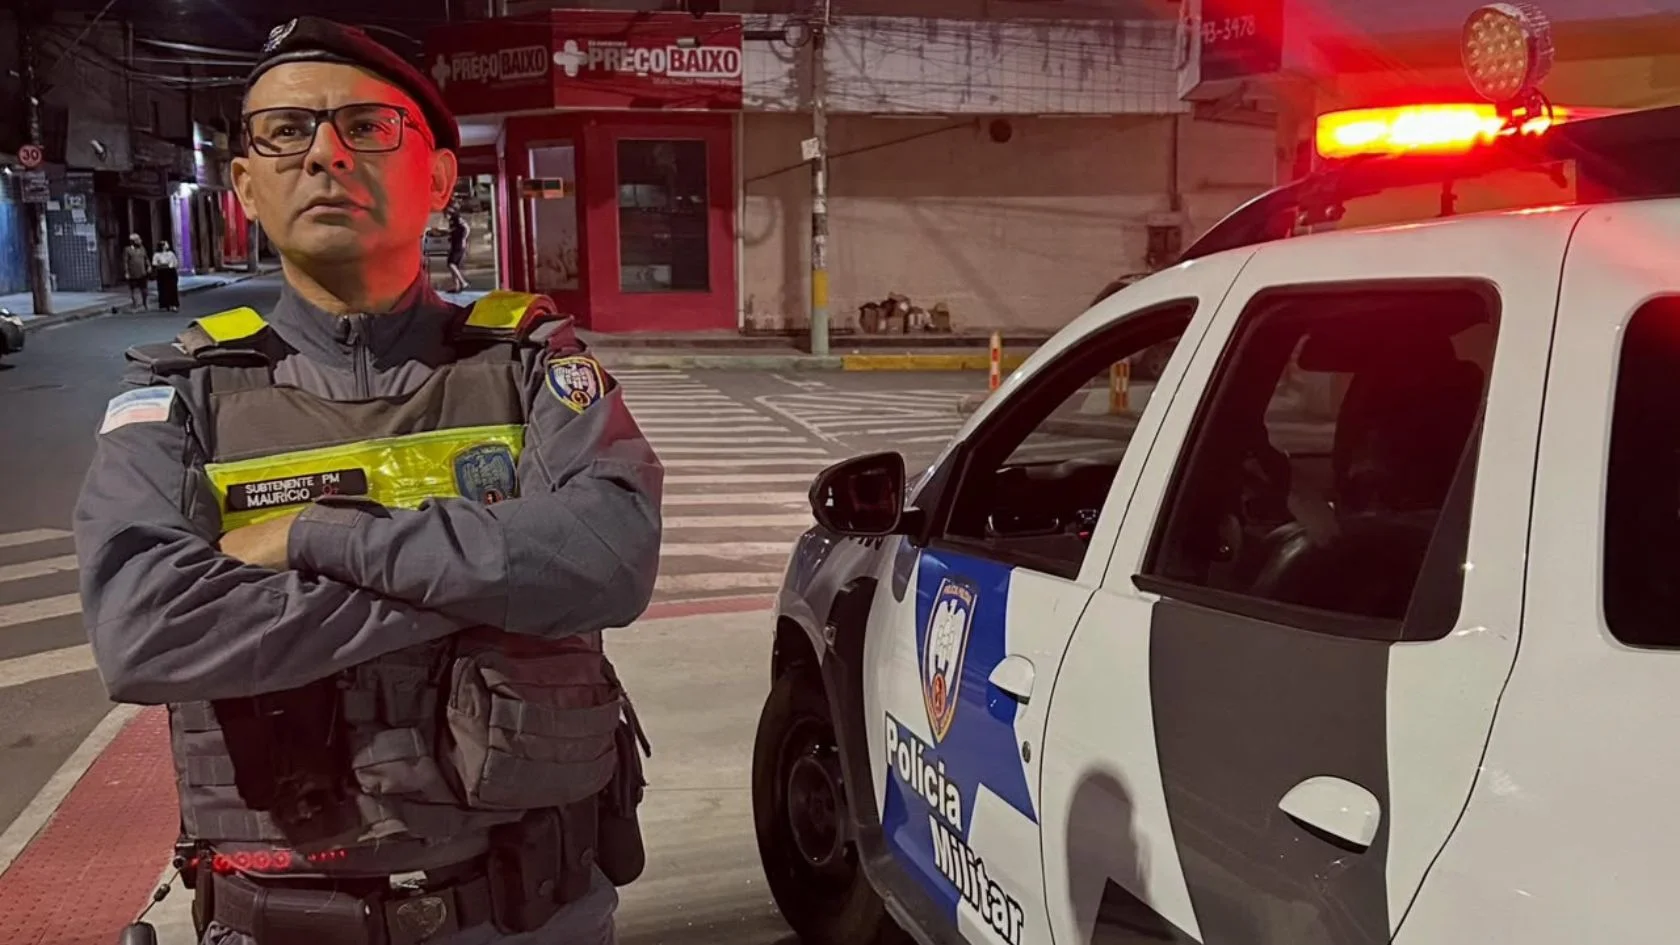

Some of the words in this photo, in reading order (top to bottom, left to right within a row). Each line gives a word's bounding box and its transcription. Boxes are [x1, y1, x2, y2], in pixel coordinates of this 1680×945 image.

[451, 53, 498, 83] PREÇO
[501, 50, 542, 77] BAIXO
[588, 48, 664, 77] PREÇO
[671, 50, 738, 73] BAIXO
[22, 149, 39, 160] 30
[245, 477, 314, 494] SUBTENENTE
[322, 473, 340, 484] PM
[886, 716, 962, 832] Polícia
[929, 814, 1025, 945] Militar
